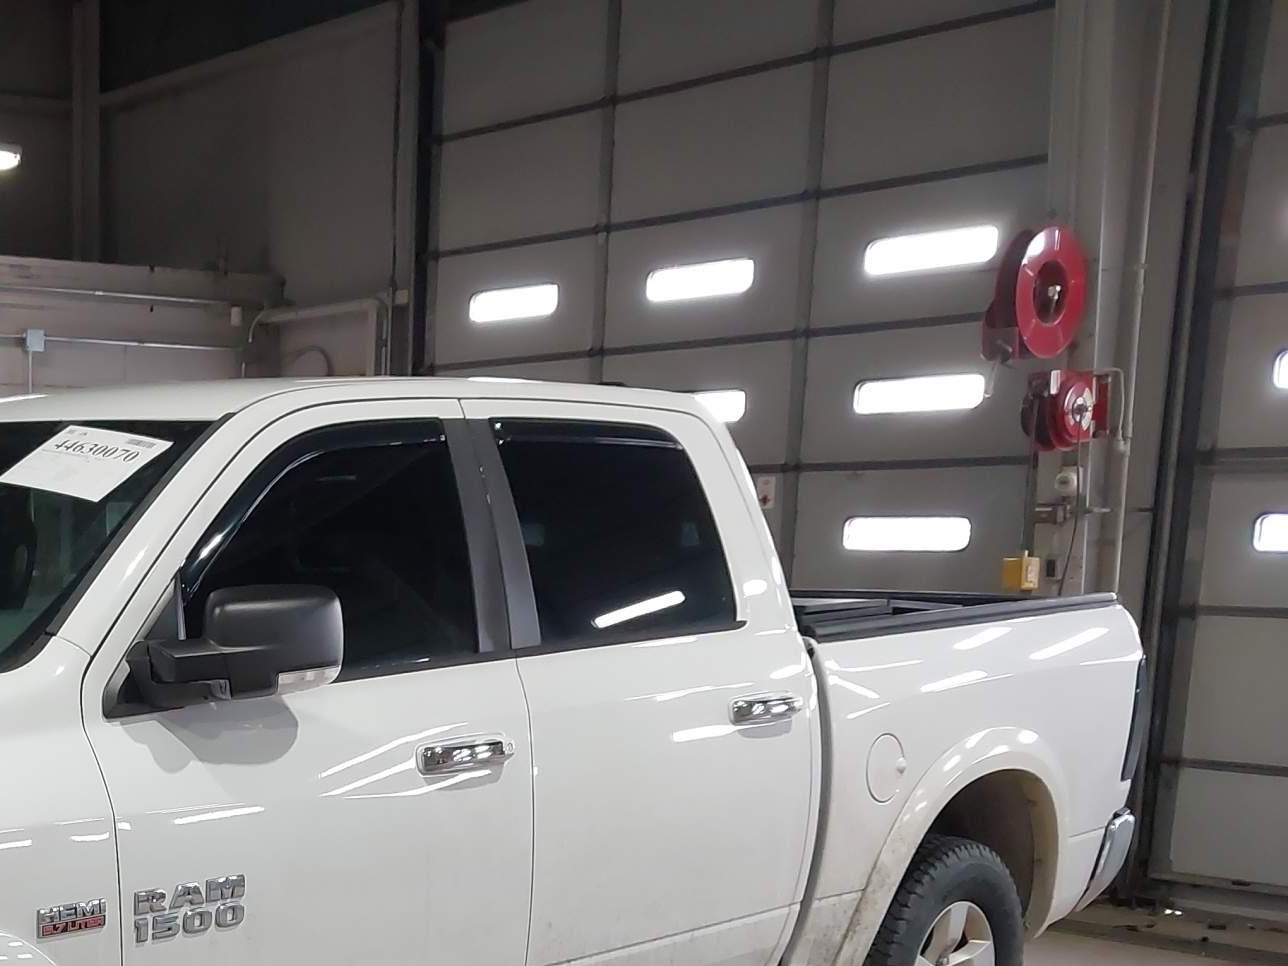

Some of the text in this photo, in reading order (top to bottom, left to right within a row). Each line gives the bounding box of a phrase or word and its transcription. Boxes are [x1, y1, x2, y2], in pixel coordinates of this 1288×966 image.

[54, 439, 140, 462] 44630070
[37, 898, 106, 924] HEMI
[133, 874, 245, 916] RAM
[135, 902, 244, 943] 1500
